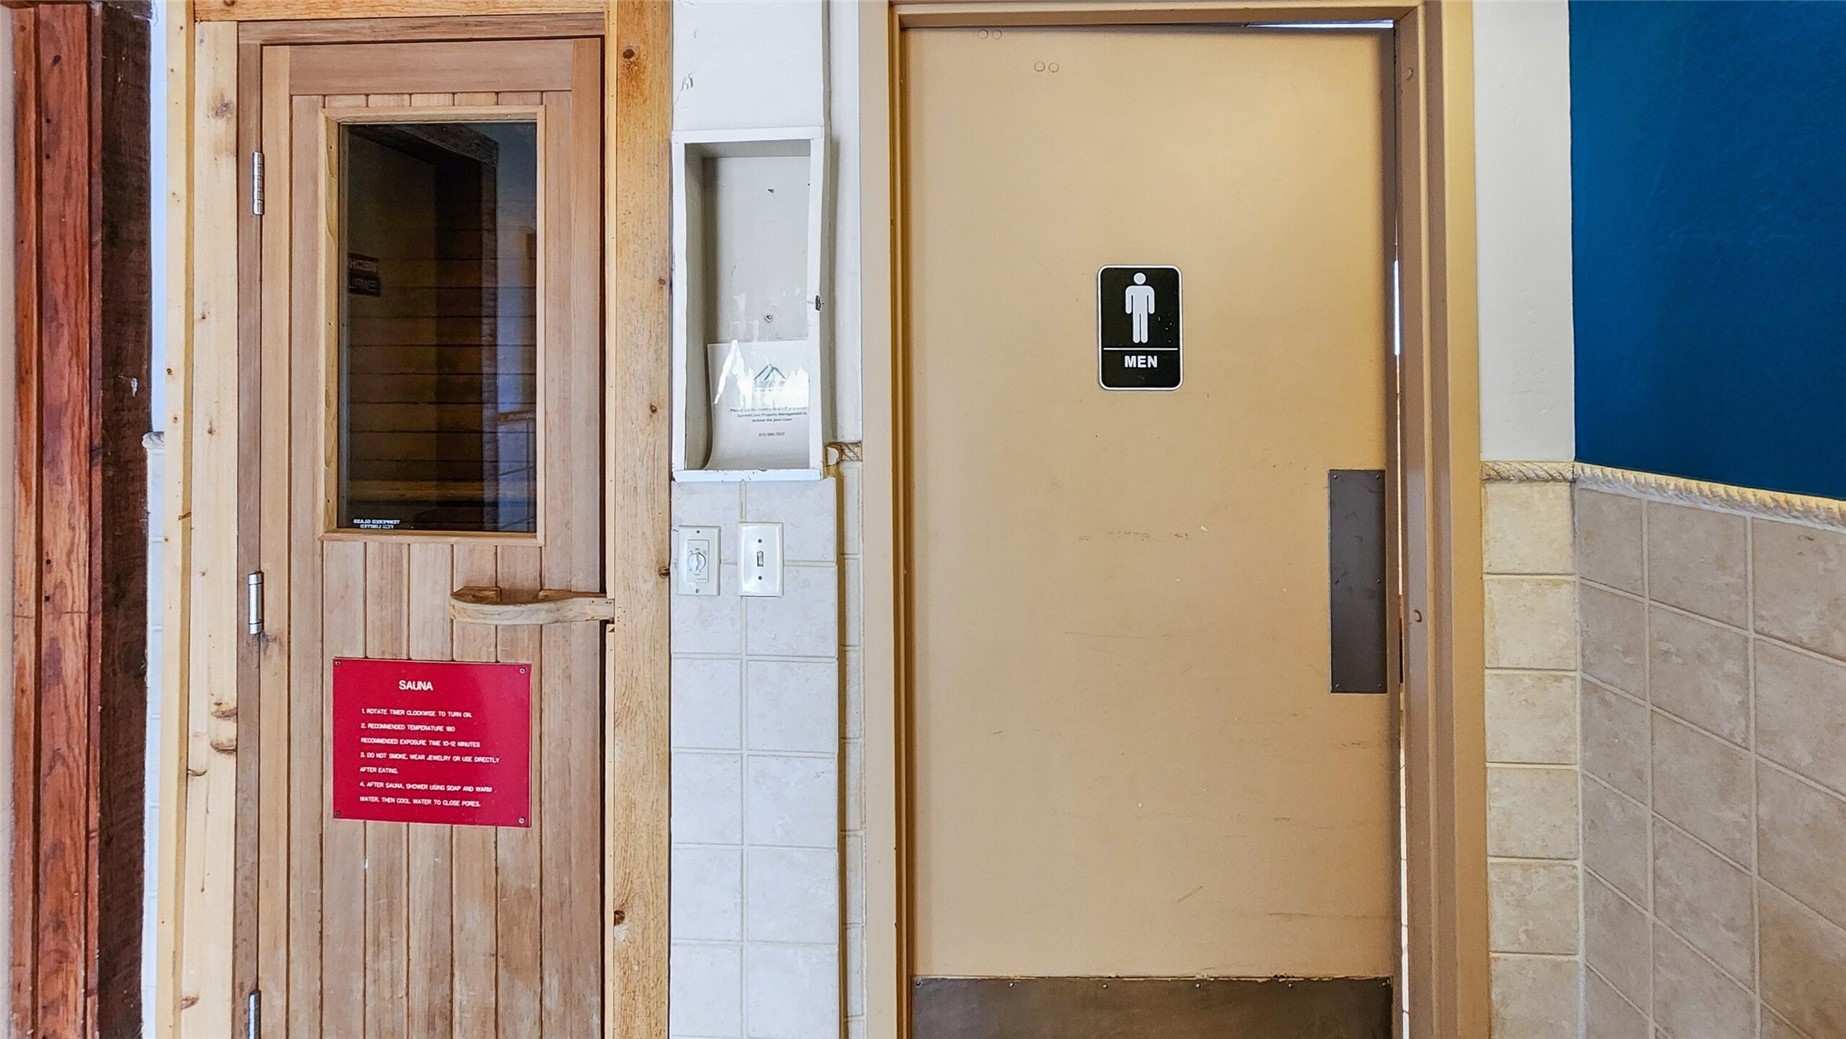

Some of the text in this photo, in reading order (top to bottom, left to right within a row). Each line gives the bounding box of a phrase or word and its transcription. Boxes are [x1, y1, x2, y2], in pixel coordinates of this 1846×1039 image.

[1124, 355, 1158, 368] MEN
[398, 679, 433, 691] SAUNA
[407, 724, 444, 732] TEMPERATURE
[442, 799, 461, 807] CLOSE
